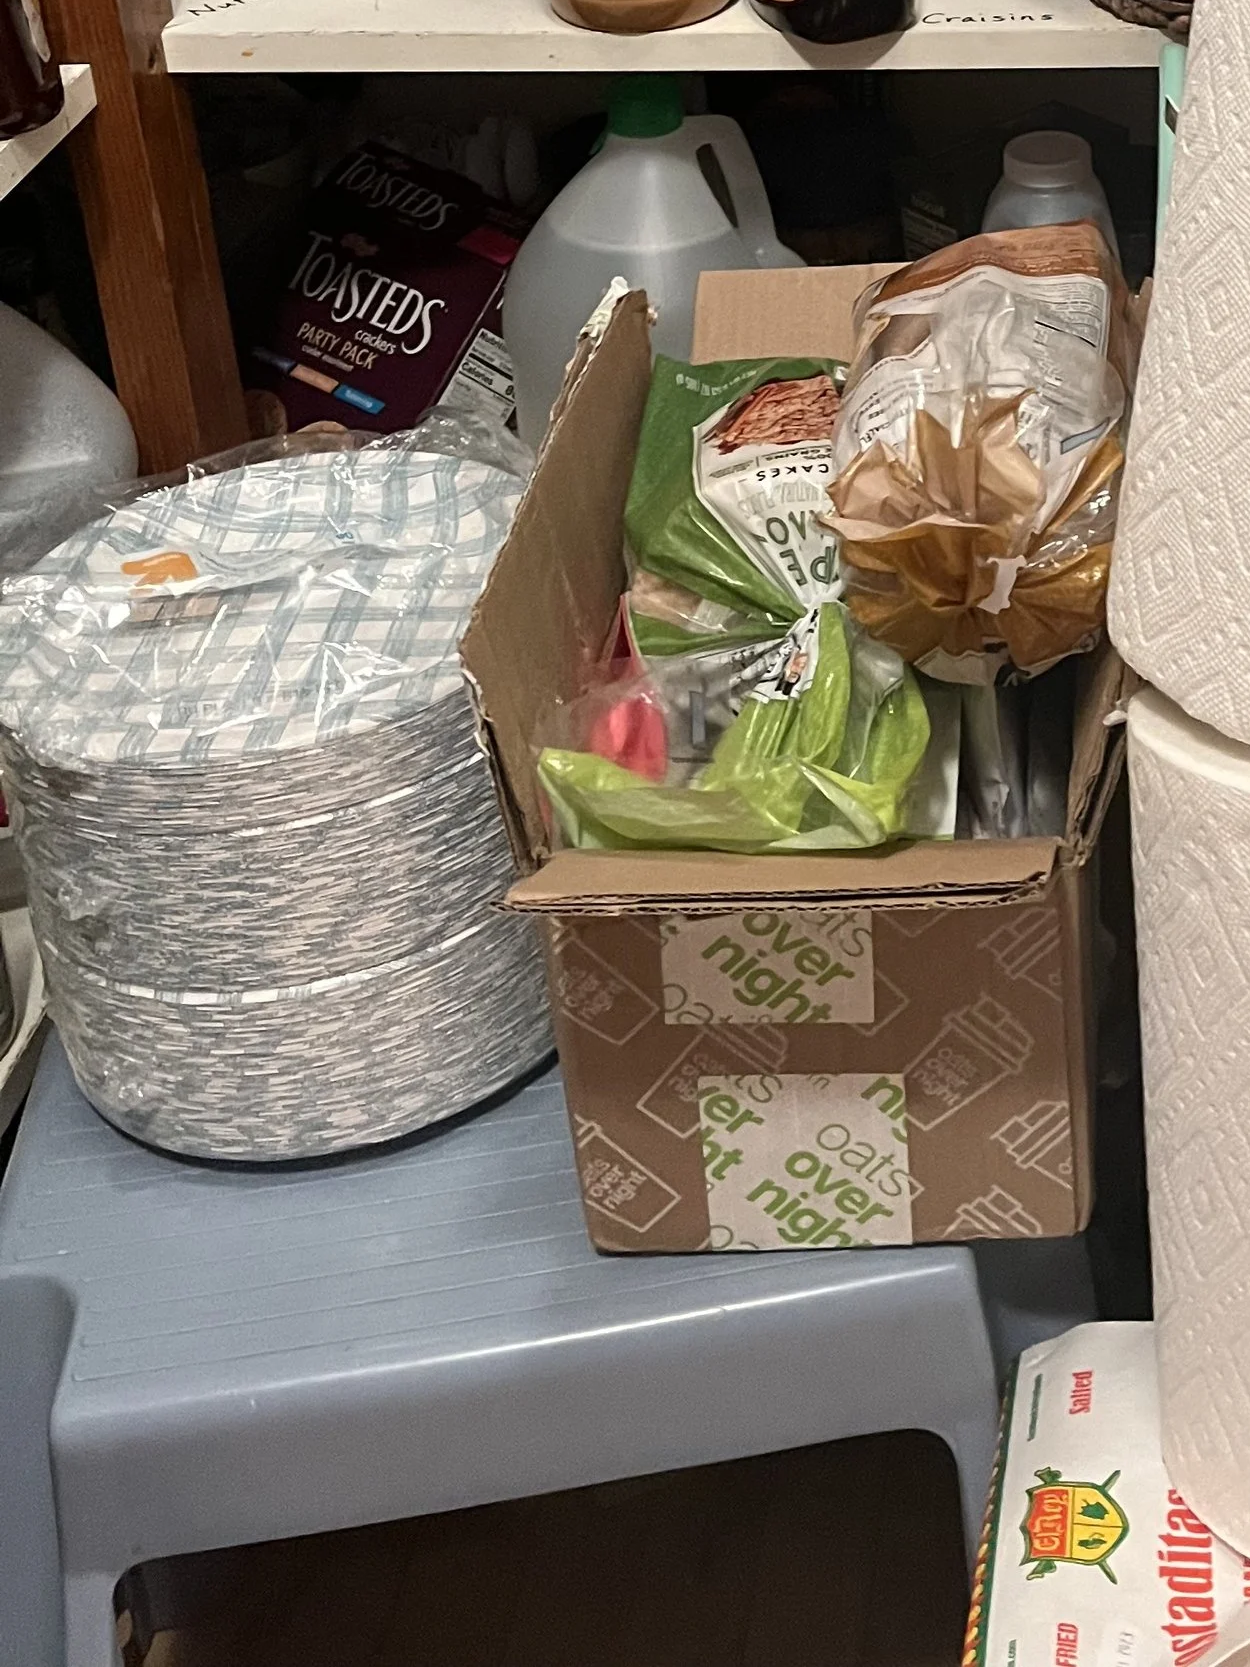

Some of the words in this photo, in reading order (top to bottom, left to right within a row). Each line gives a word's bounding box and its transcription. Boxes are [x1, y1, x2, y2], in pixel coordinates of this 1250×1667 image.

[921, 12, 1055, 25] Craisins
[335, 151, 459, 231] TOASTEDS
[288, 229, 446, 355] TOASTEDS
[296, 321, 339, 353] PARTY
[340, 340, 378, 370] PACK
[353, 328, 397, 356] crackers
[755, 463, 830, 482] CAKES
[701, 934, 834, 1024] night
[742, 912, 856, 986] over
[783, 1150, 894, 1226] over
[815, 1123, 906, 1199] oats
[746, 1176, 874, 1248] nigh
[1069, 1368, 1094, 1416] Salted
[1055, 1621, 1079, 1667] FRIED
